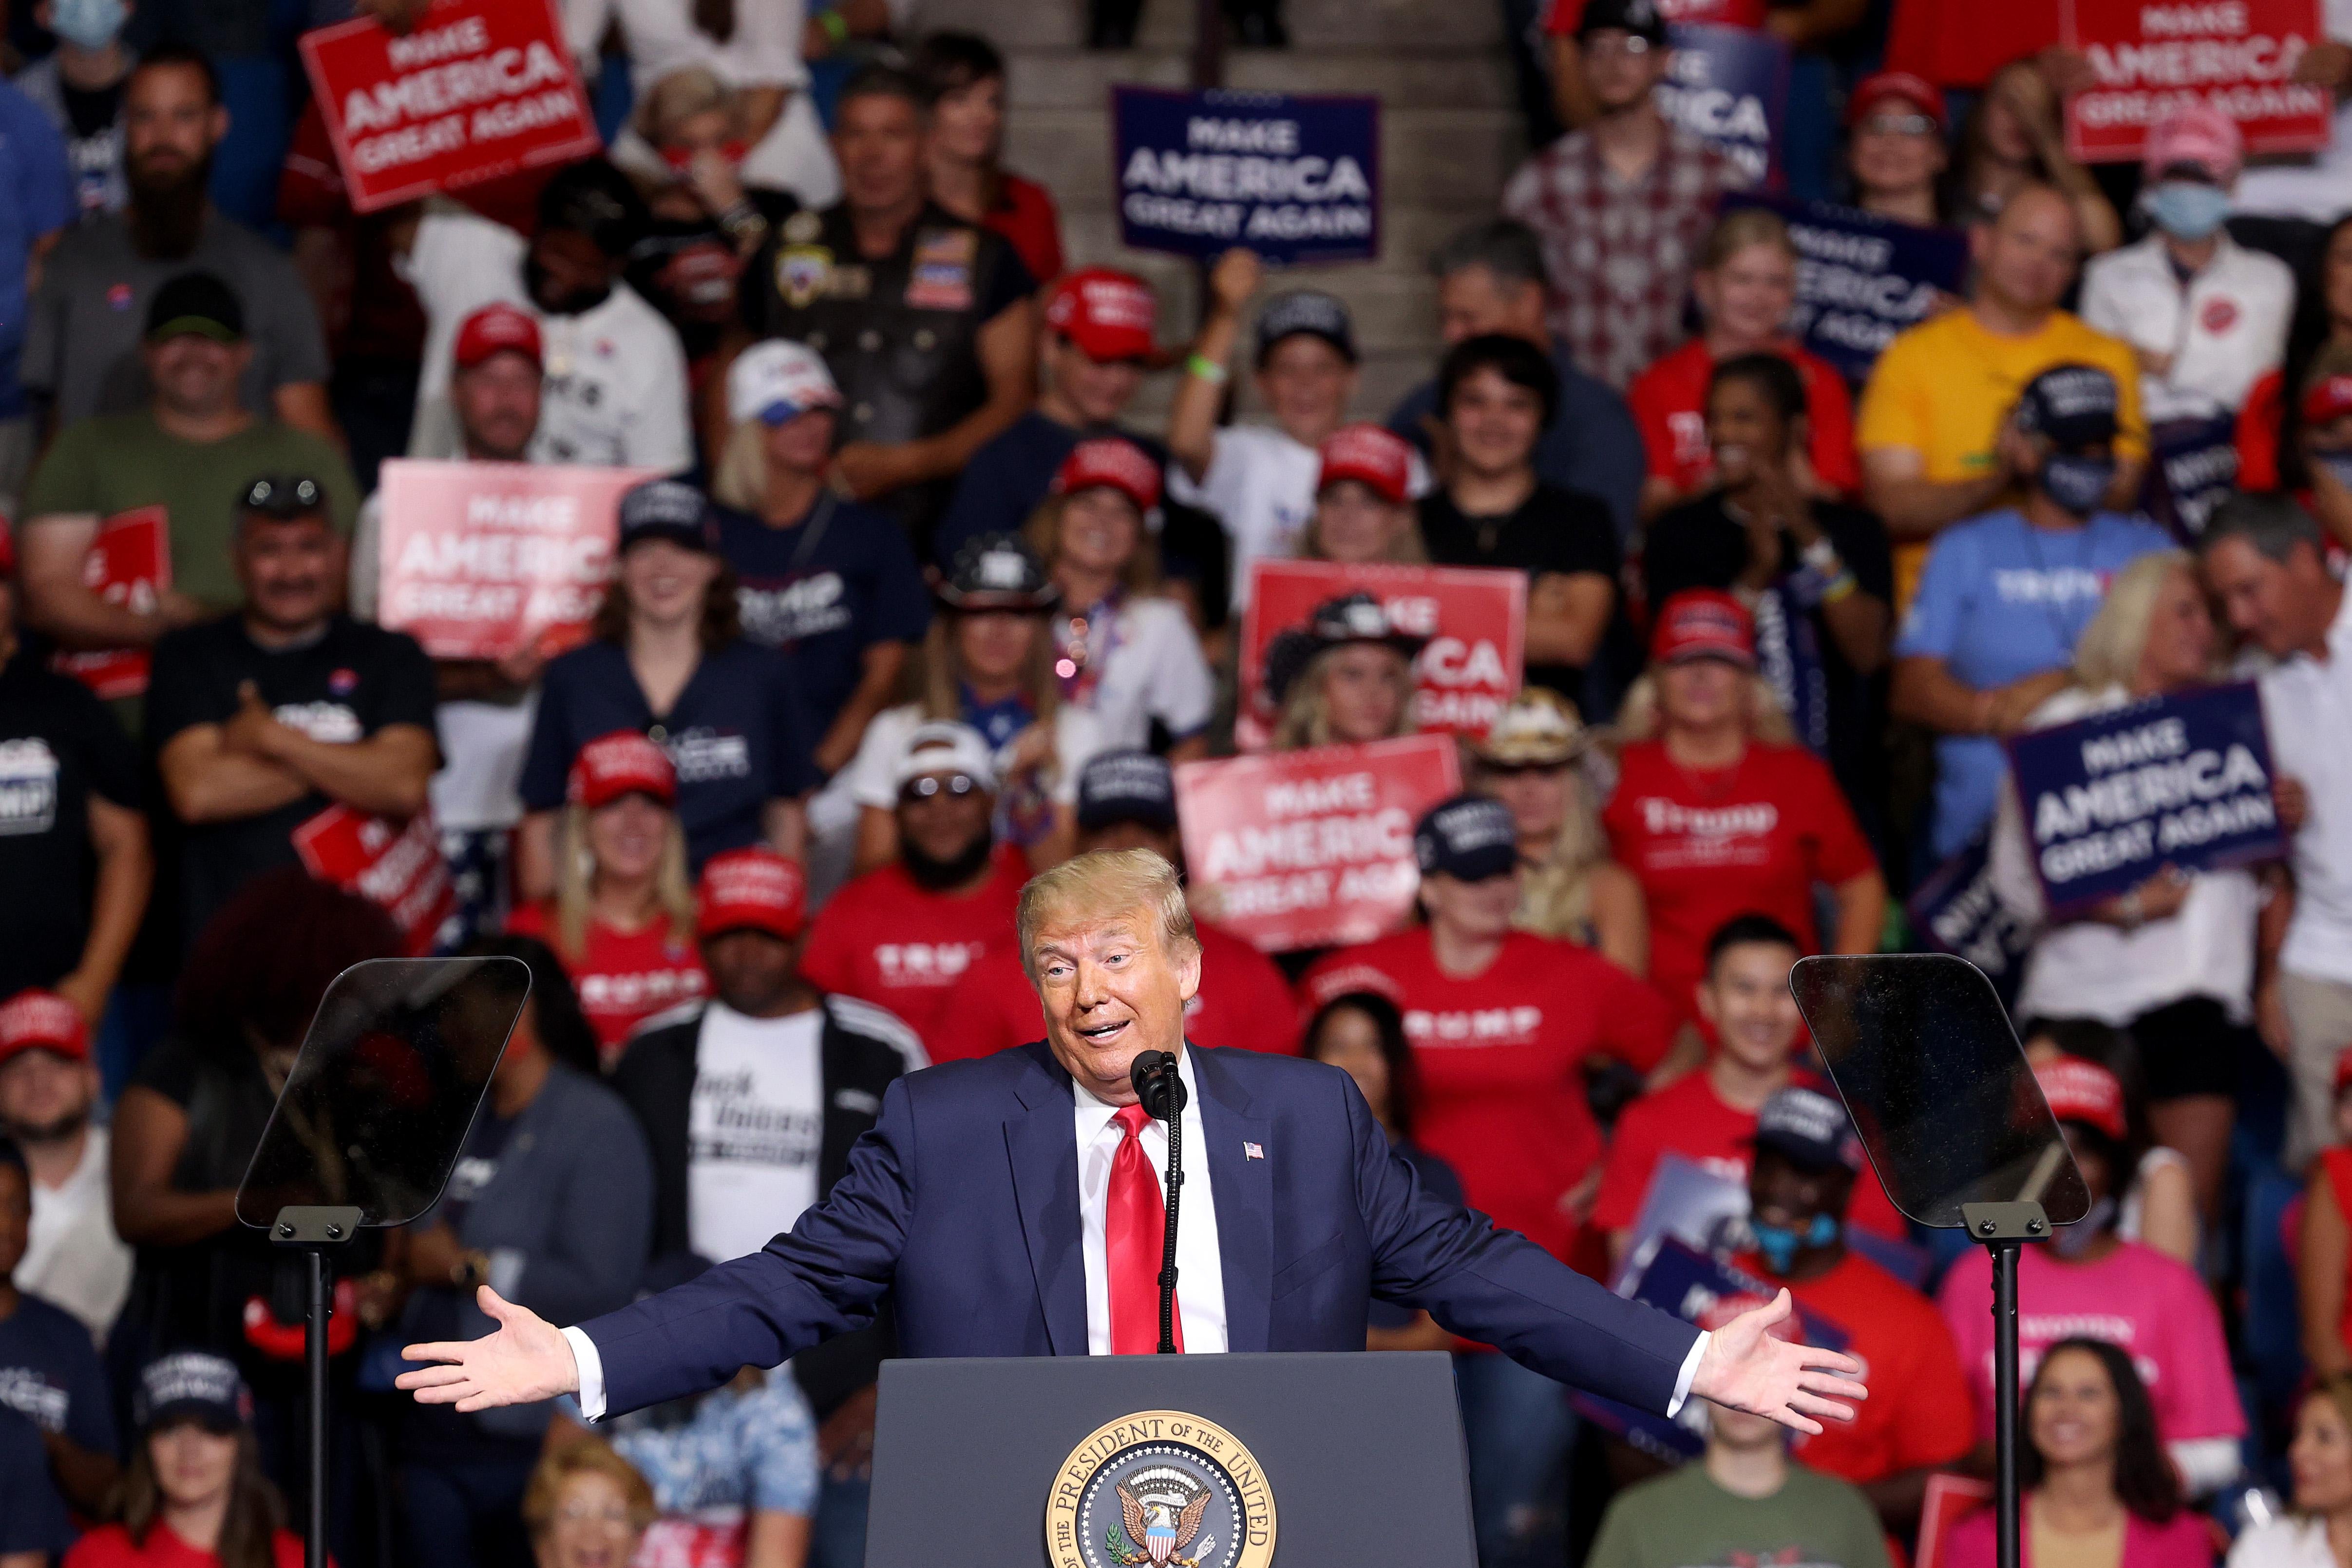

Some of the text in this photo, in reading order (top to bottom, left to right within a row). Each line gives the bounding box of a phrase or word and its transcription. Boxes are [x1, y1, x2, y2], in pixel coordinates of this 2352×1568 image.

[389, 17, 489, 67] MAKE
[2145, 4, 2246, 37] MAKE
[344, 41, 566, 132] AMERICA
[1672, 50, 1709, 81] KE
[352, 91, 579, 174] GREAT AGAIN
[1188, 117, 1300, 153] MAKE
[1652, 83, 1769, 142] RICA
[1123, 147, 1370, 201] AMERICA
[1123, 193, 1371, 240] GREAT AGAIN
[1788, 223, 1892, 270] MAKE
[1795, 261, 1933, 318] ERICA
[468, 495, 573, 526] MAKE
[398, 531, 608, 582] AMERIC
[398, 586, 604, 622] GREAT AGA
[1384, 597, 1438, 635] KE
[1411, 690, 1500, 727] GAIN
[2083, 717, 2190, 772] MAKE
[1266, 774, 1374, 812] MAKE
[2034, 744, 2267, 842] AMERICA
[1205, 808, 1412, 882] AMERIC
[2040, 794, 2276, 882] GREAT AGAIN
[1222, 862, 1419, 917] GREAT AGA
[874, 943, 973, 975] TRU
[581, 969, 705, 1002] RUMP
[1403, 1006, 1543, 1039] RUMP
[1171, 1423, 1192, 1437] OF
[1197, 1429, 1223, 1453] THE
[1056, 1419, 1163, 1512] PRESIDENT
[1228, 1452, 1268, 1546] UNITED
[1057, 1521, 1072, 1551] THE
